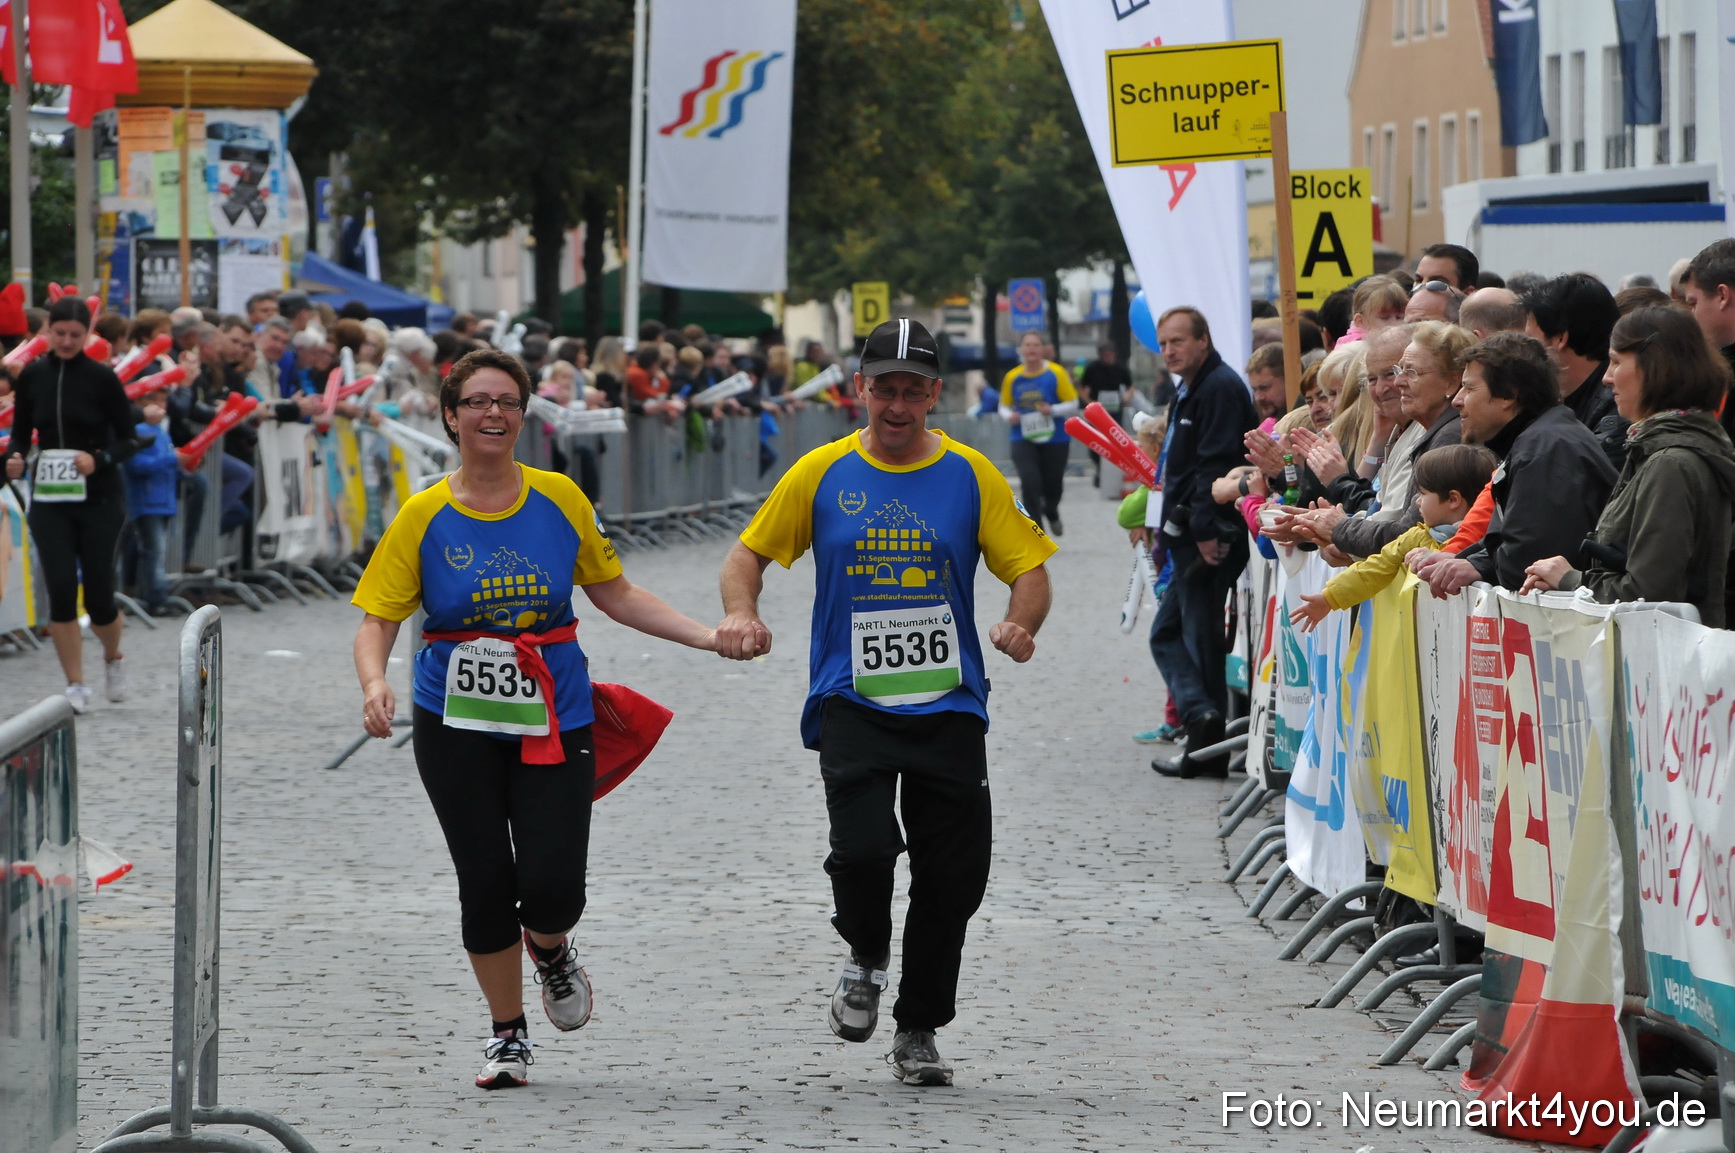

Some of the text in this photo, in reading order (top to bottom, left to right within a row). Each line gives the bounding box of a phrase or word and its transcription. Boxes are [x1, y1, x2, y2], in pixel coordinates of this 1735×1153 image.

[1120, 78, 1270, 105] Schnupper-
[1173, 109, 1220, 133] lauf
[1291, 175, 1362, 199] Block
[1301, 212, 1353, 277] A
[863, 299, 880, 323] D
[857, 555, 931, 563] 21.September 2014
[475, 599, 549, 612] 21.September 2014
[853, 616, 938, 631] PARTL Neumarkt
[863, 629, 949, 671] 5536
[456, 657, 537, 698] 5535
